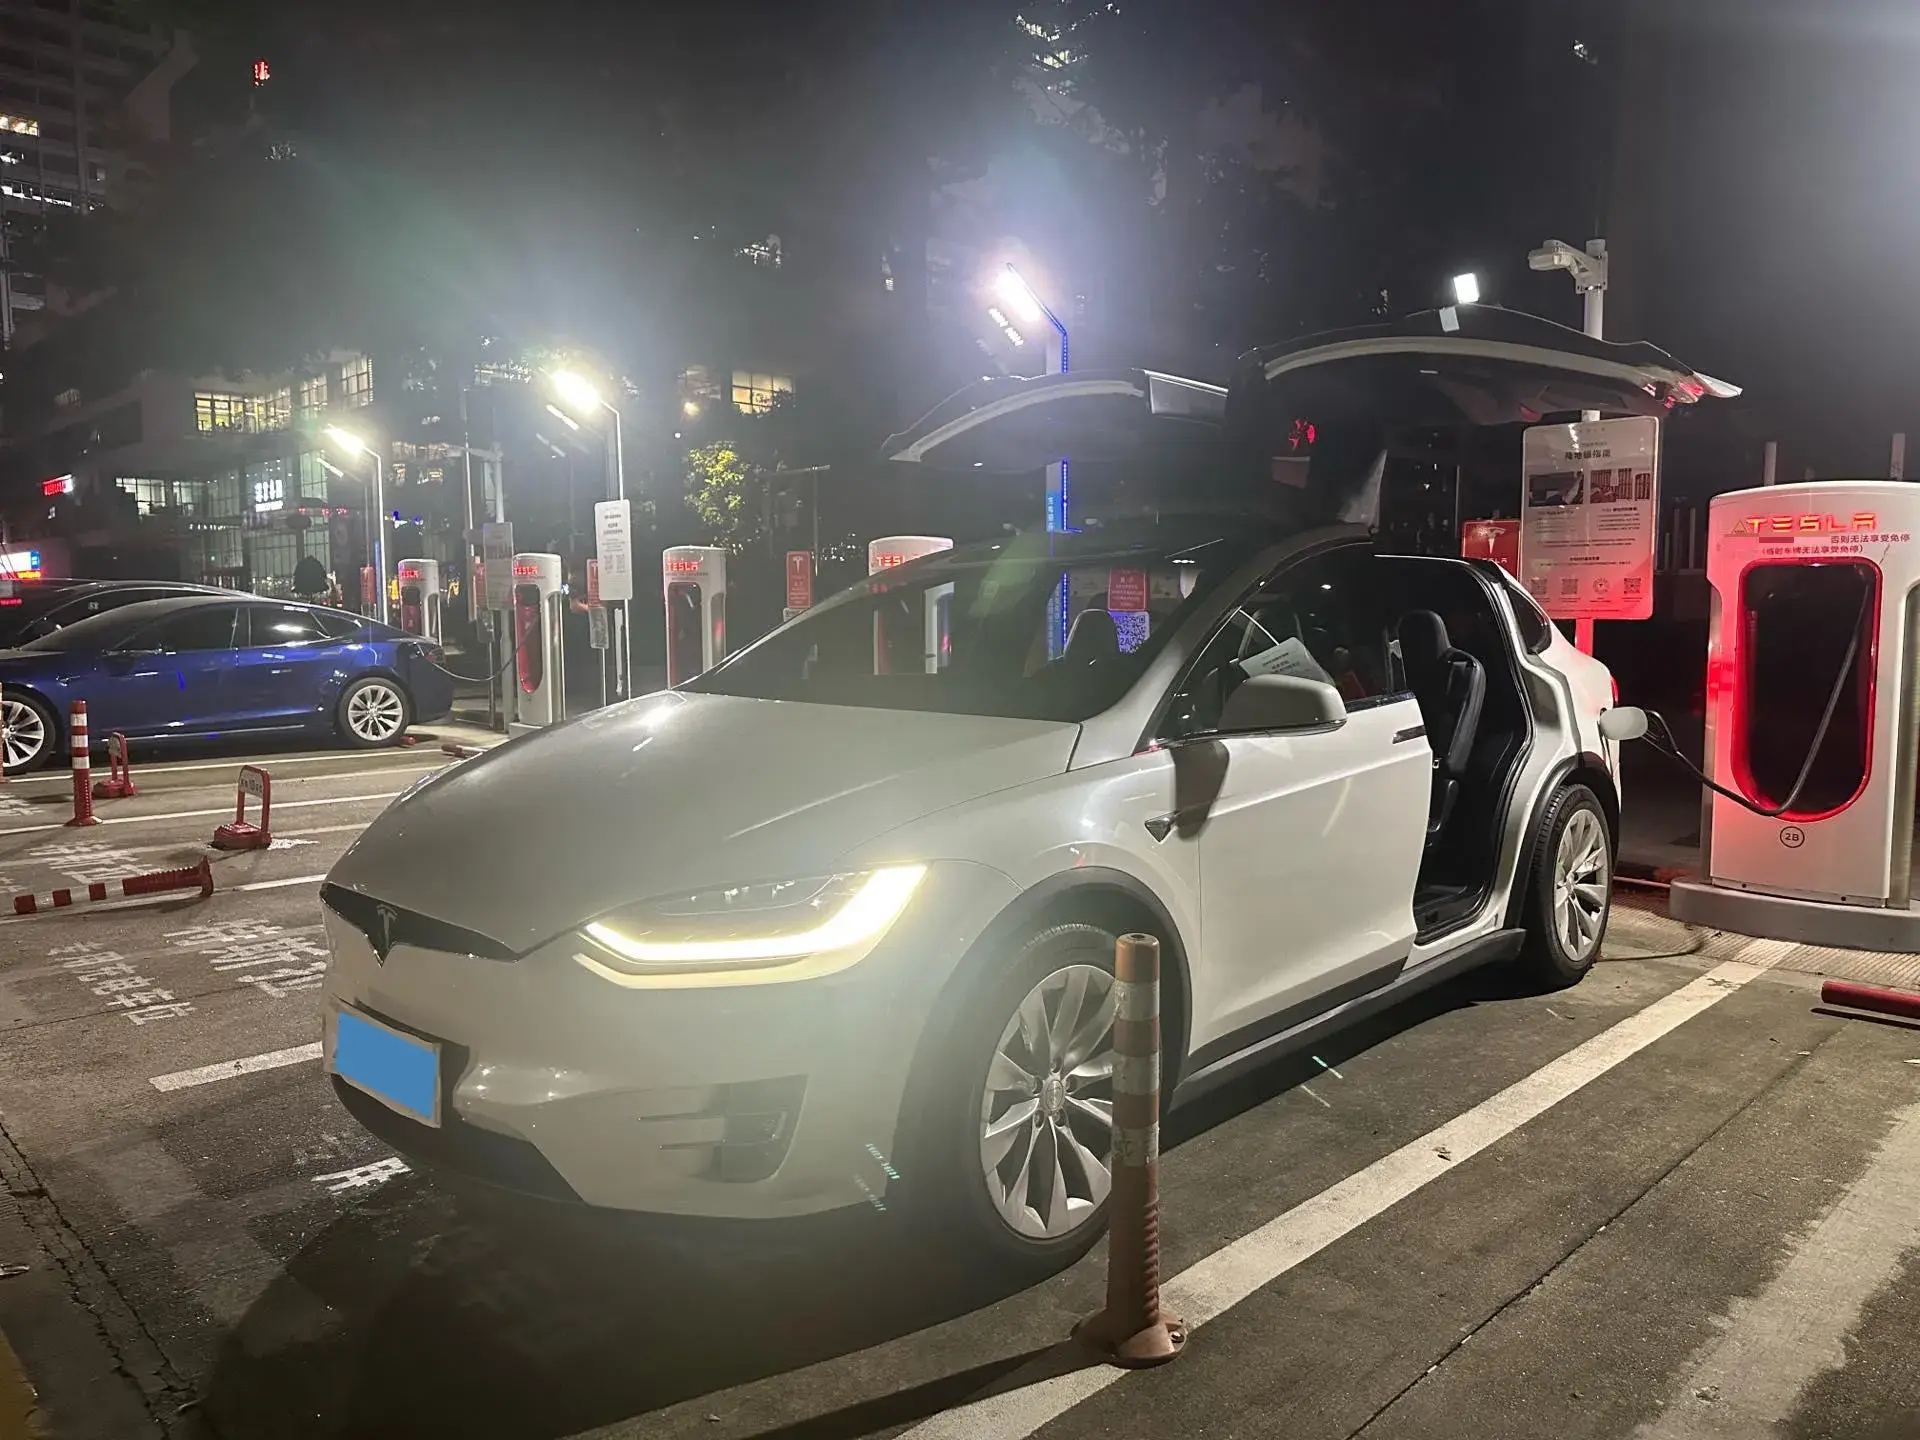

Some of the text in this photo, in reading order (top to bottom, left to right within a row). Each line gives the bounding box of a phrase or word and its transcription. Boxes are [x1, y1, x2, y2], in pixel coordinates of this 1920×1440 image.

[1746, 513, 1876, 533] TESLA
[1831, 533, 1910, 544] 否则无法享受免停
[667, 561, 699, 572] TESLA
[1785, 832, 1799, 842] 2B
